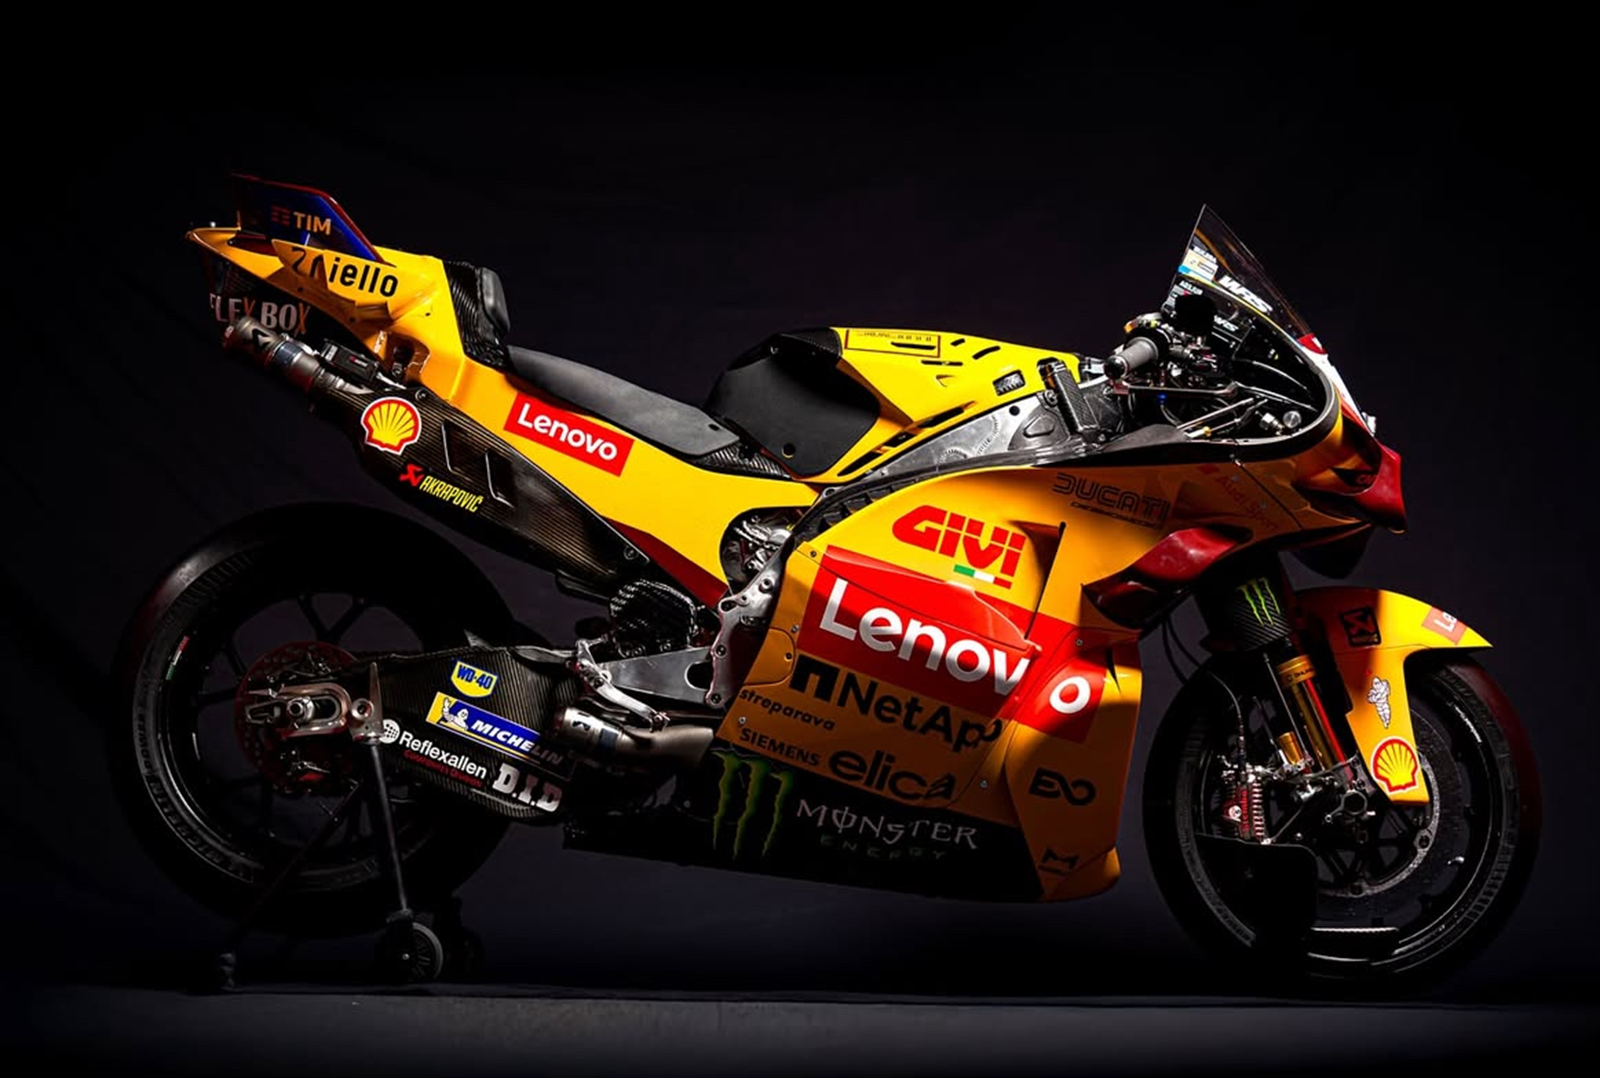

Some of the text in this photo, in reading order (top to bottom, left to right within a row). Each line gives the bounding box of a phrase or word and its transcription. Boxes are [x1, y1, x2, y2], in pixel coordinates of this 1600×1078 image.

[293, 211, 331, 236] TIM
[516, 402, 619, 462] Lenovo
[1051, 472, 1171, 524] DUCATI
[892, 505, 1027, 578] GIVI
[819, 577, 1092, 714] Lenovo
[457, 664, 493, 690] WD-40
[739, 688, 836, 731] streparava
[398, 730, 488, 780] Reflexallen
[471, 718, 564, 766] MICHELIN
[740, 728, 821, 767] SIEMENS
[829, 751, 957, 801] elica
